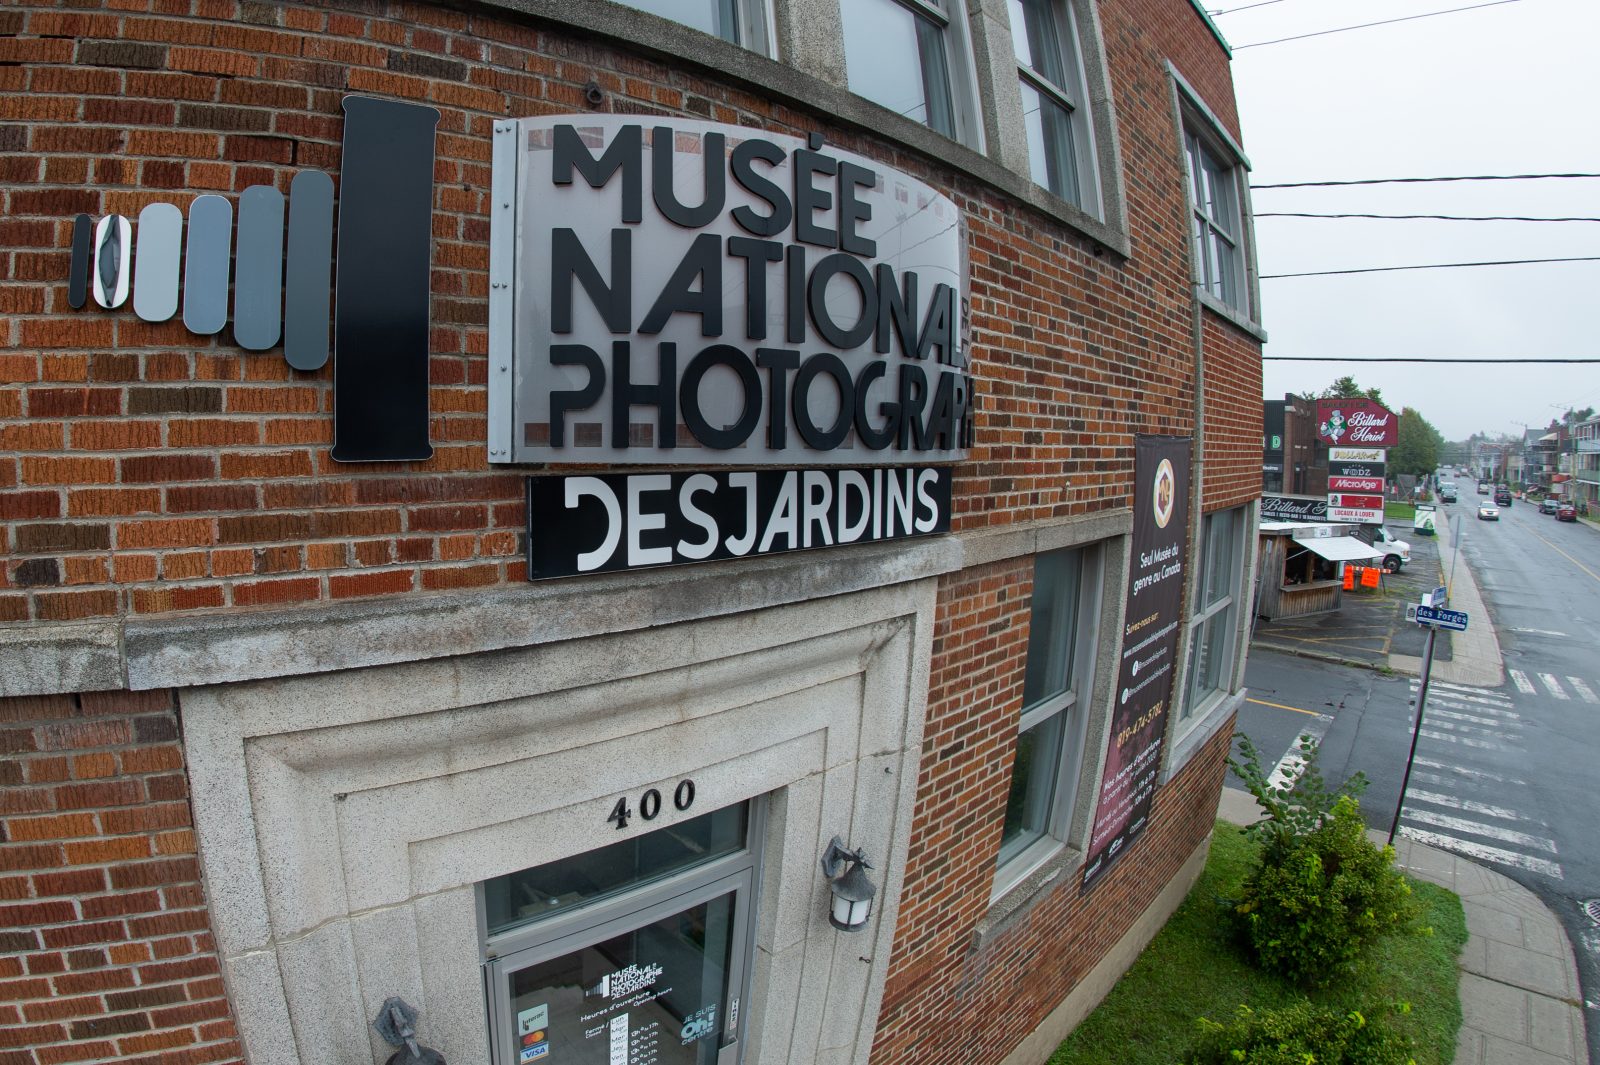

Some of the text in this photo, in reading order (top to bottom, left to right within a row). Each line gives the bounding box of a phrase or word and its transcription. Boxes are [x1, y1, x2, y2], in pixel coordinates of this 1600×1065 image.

[552, 124, 877, 258] MUSÉE
[551, 227, 963, 367] NATIONAL
[1347, 411, 1389, 427] Billard
[1260, 498, 1312, 514] Billard
[1359, 510, 1375, 518] LOUER
[564, 467, 940, 572] DESJARDINS
[1140, 542, 1180, 569] Seul Musée du
[1133, 560, 1181, 596] genre au Canada
[1418, 607, 1433, 617] des
[1437, 611, 1467, 624] Forges
[1117, 700, 1163, 749] 819-474-5782
[607, 779, 696, 830] 400
[611, 963, 638, 979] MUSÉE
[611, 965, 653, 987] NATIONAL
[611, 976, 656, 1000] DESJARDINS
[633, 987, 673, 1007] Opening hours
[581, 991, 650, 1022] Heures d'ouverture
[683, 1003, 716, 1025] JE SUIS
[681, 1027, 713, 1046] centre
[525, 1047, 546, 1058] VISA
